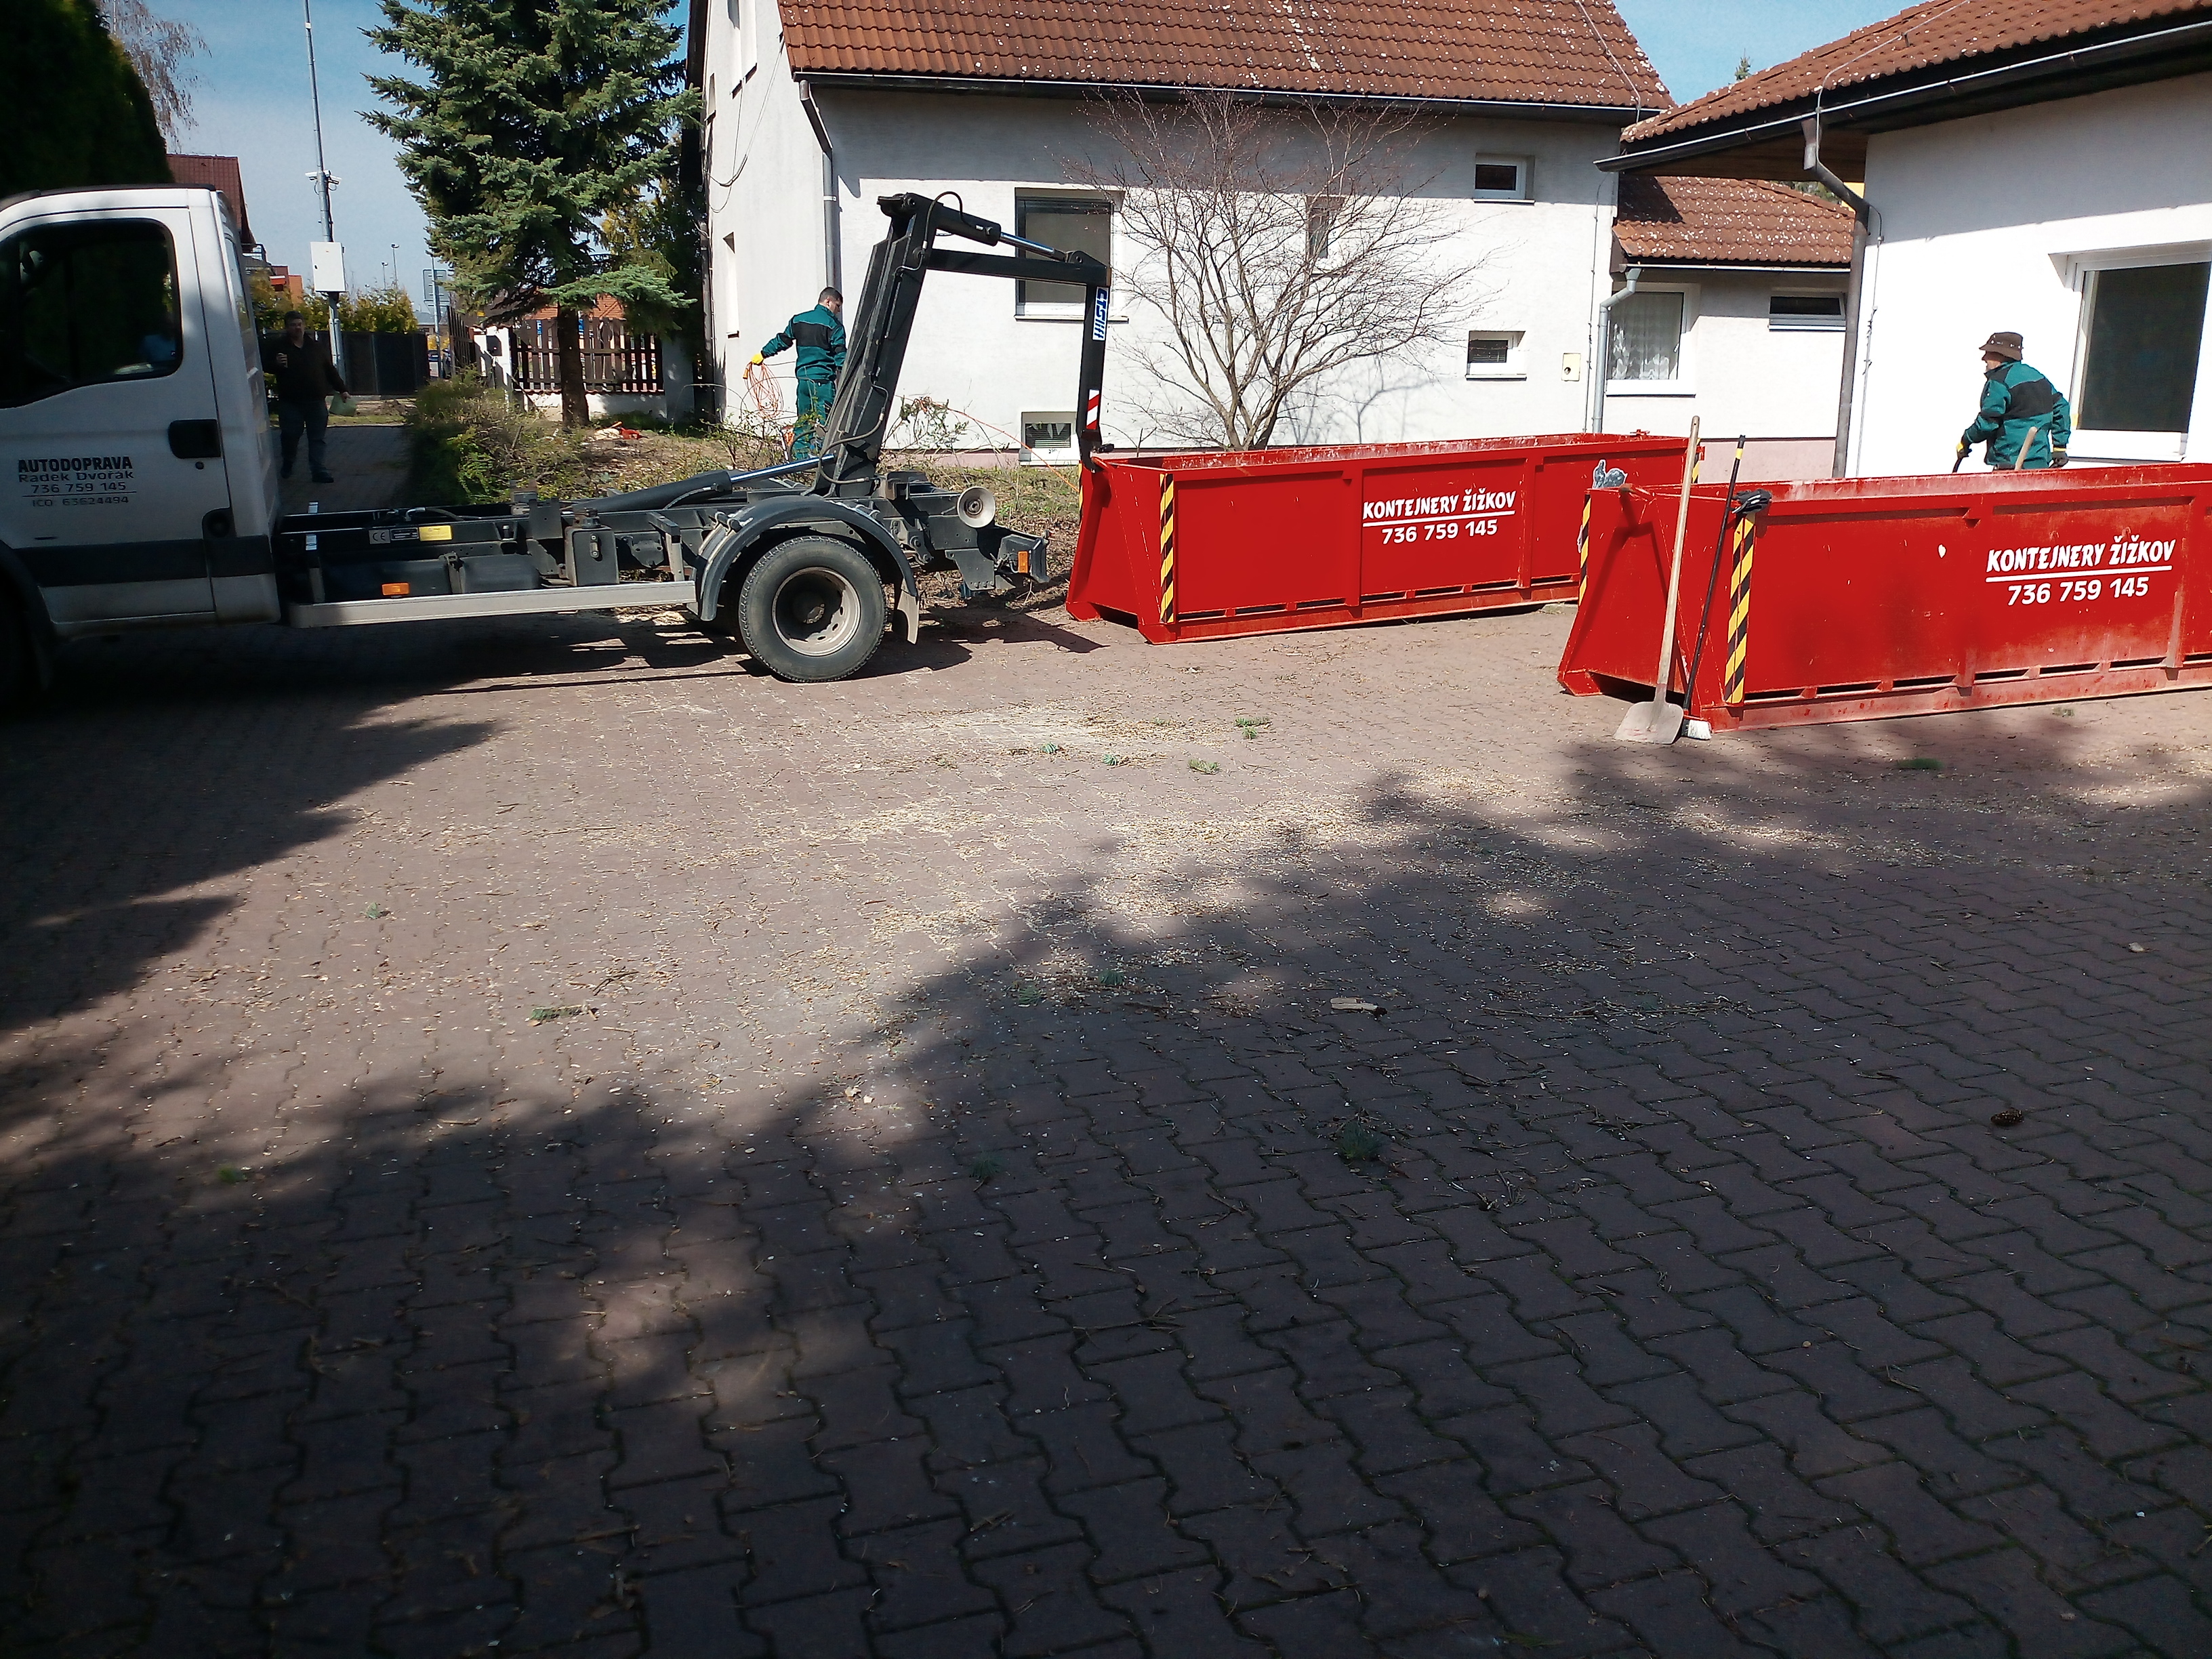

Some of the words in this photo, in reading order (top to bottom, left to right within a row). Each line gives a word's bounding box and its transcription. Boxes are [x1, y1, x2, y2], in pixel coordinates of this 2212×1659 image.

[18, 457, 133, 473] AUTODOPRAVA
[18, 474, 70, 483] Radek
[31, 484, 60, 493] 736
[66, 483, 94, 492] 759
[100, 482, 126, 491] 145
[1363, 495, 1459, 520] KONTEJNERY
[1462, 487, 1516, 512] ŽIŽKOV
[1382, 526, 1417, 544] 736
[1425, 523, 1458, 541] 759
[1465, 519, 1498, 537] 145
[1986, 543, 2106, 573] KONTEJNERY
[2108, 534, 2176, 565] ŽIŽKOV
[2007, 583, 2051, 606] 736
[2060, 579, 2102, 602] 759
[2110, 576, 2150, 598] 145
